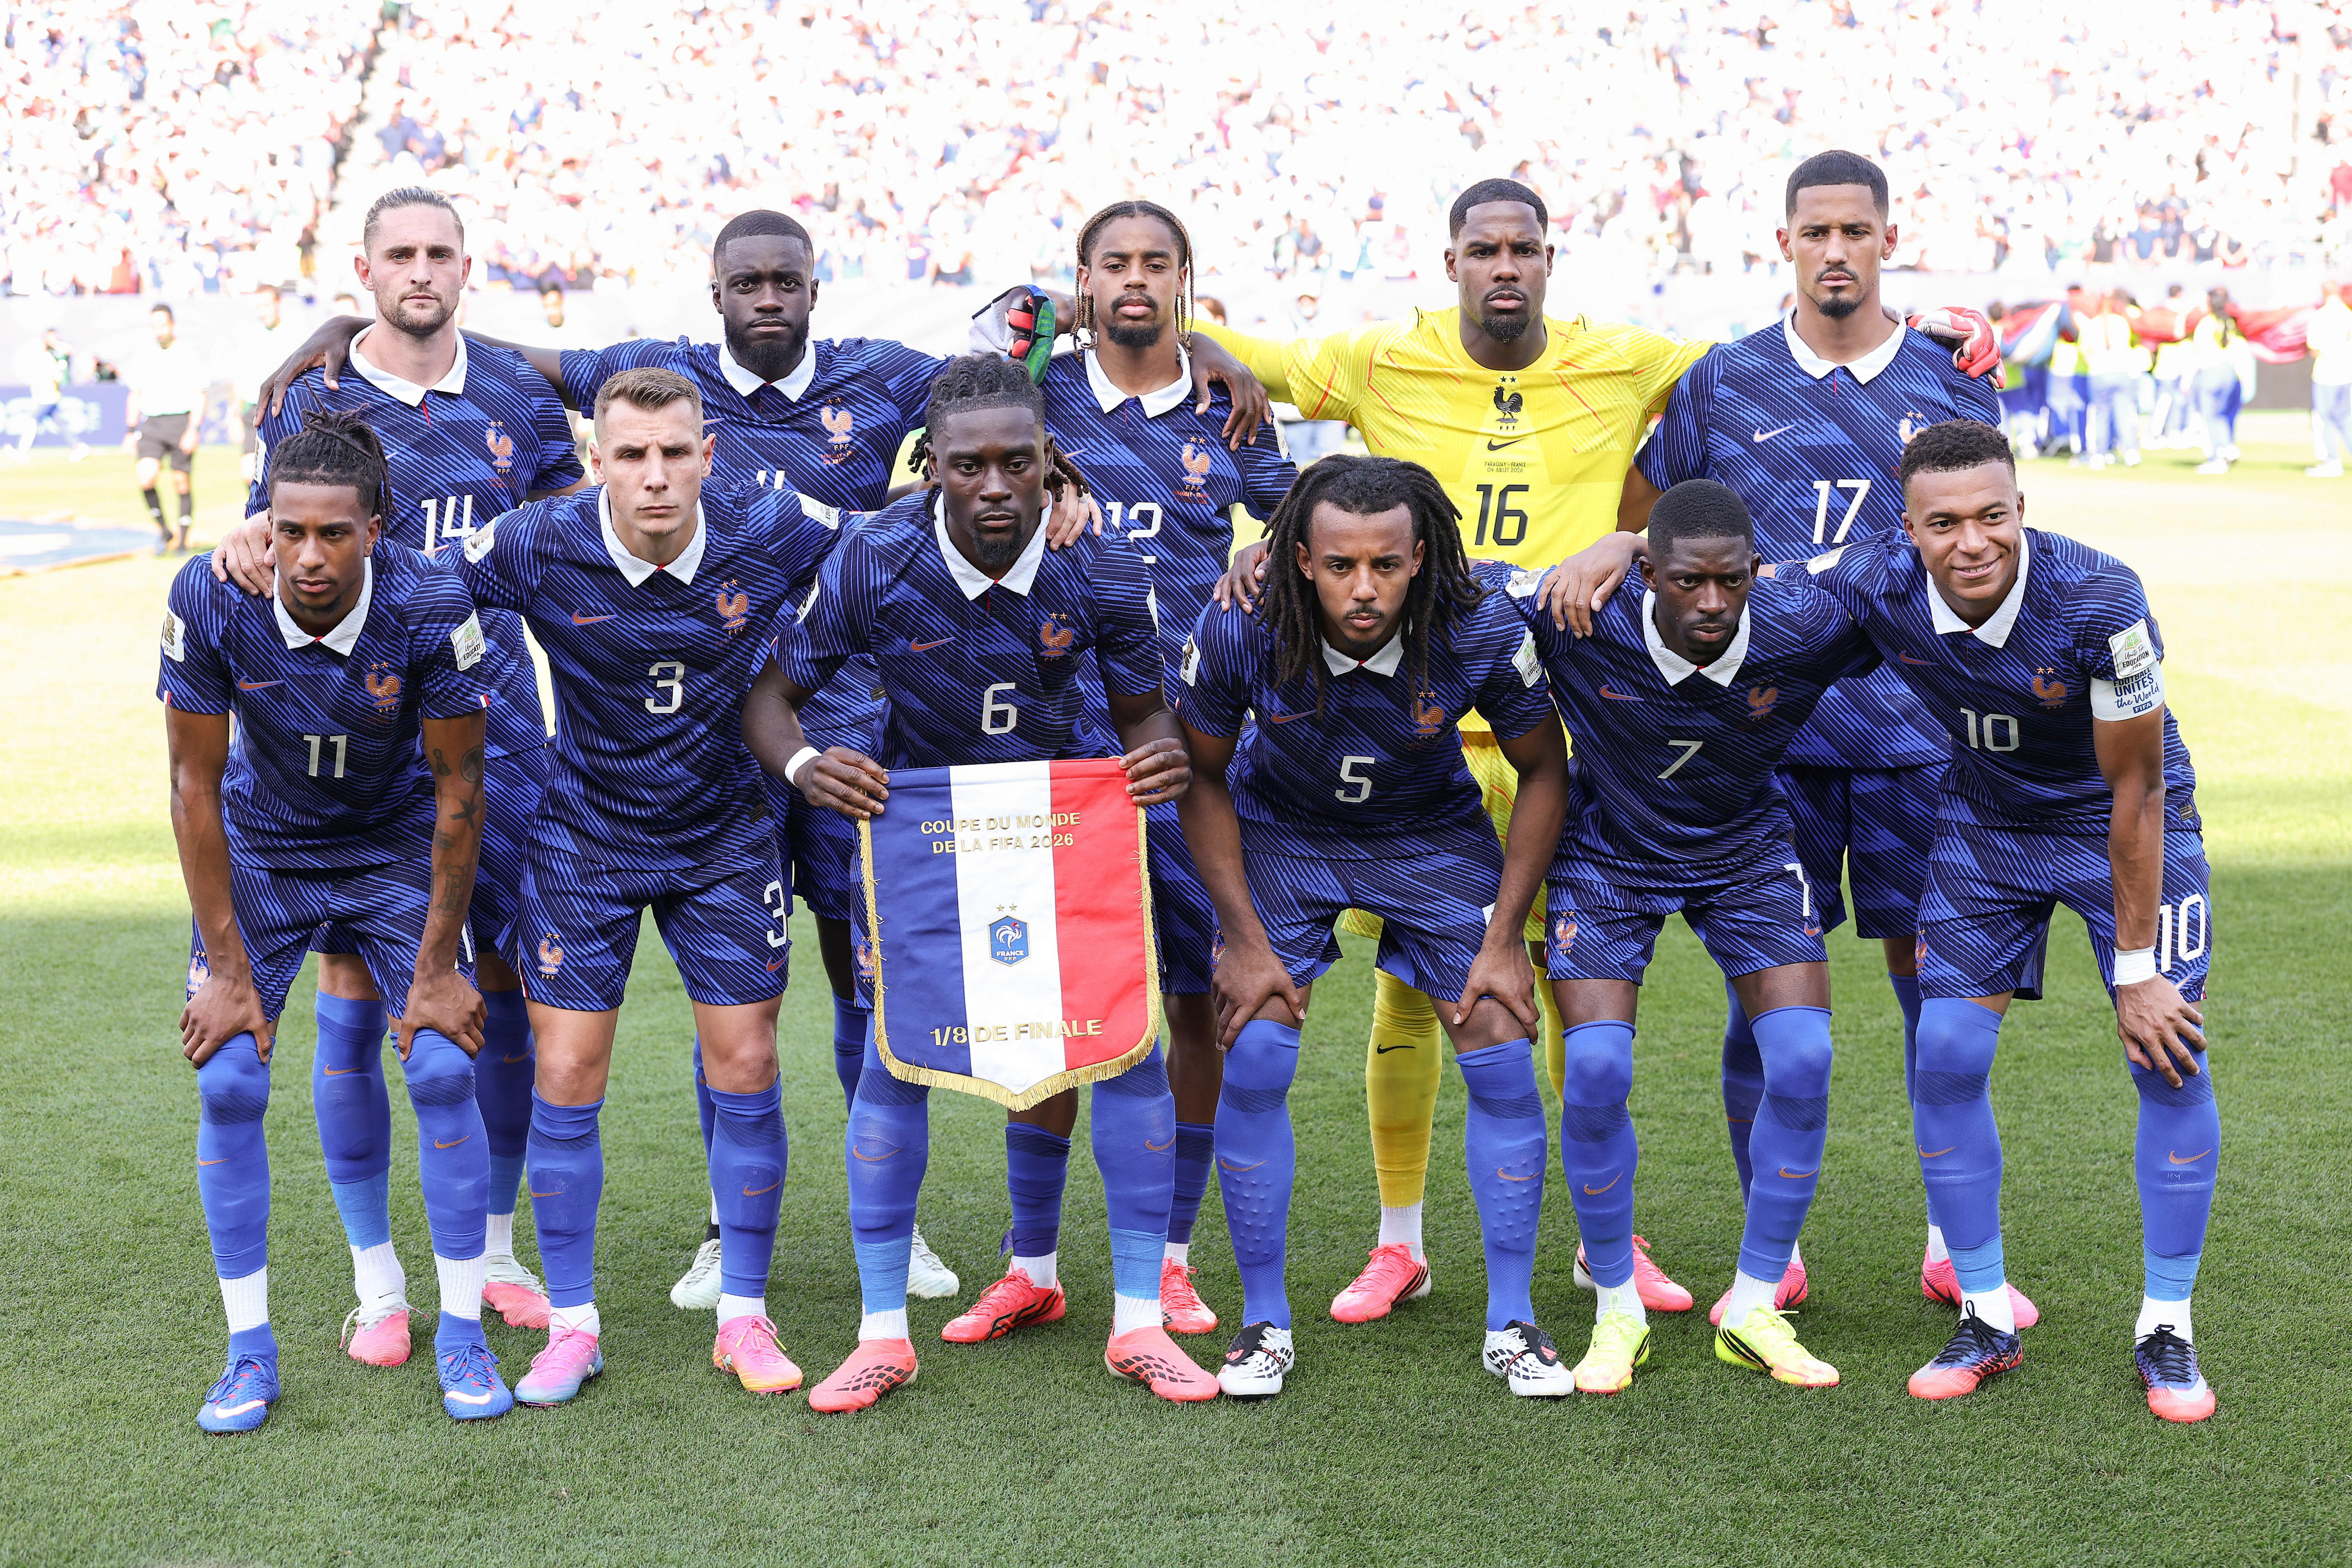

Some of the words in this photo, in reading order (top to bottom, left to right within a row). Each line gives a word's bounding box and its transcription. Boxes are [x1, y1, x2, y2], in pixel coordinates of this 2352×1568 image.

[421, 494, 476, 551] 14
[1475, 484, 1529, 546] 16
[1812, 479, 1871, 544] 17
[729, 626, 744, 635] FFF
[464, 644, 481, 660] EDUCATI
[2123, 650, 2150, 668] EDUCATION
[2125, 649, 2138, 659] Unite
[1528, 661, 1539, 677] EDUCA
[2113, 668, 2151, 687] FOOTBALL
[645, 661, 686, 714] 3
[2114, 673, 2153, 697] UNITES
[2114, 697, 2133, 708] the
[2133, 682, 2160, 703] World
[981, 682, 1018, 735] 6
[2134, 702, 2152, 712] FIFA
[1961, 707, 2020, 752] 10
[303, 735, 347, 778] 11
[1657, 740, 1704, 779] 7
[1335, 755, 1376, 803] 5
[920, 819, 980, 835] COUPE
[986, 816, 1010, 830] DU
[1017, 813, 1081, 829] MONDE
[932, 840, 956, 854] DE
[961, 838, 983, 852] LA
[989, 837, 1024, 851] FIFA
[1030, 833, 1074, 848] 2026
[763, 880, 787, 948] 3
[2159, 893, 2205, 973] 10
[929, 1026, 968, 1046] 1/8
[975, 1026, 1008, 1042] DE
[1014, 1019, 1103, 1041] FINALE
